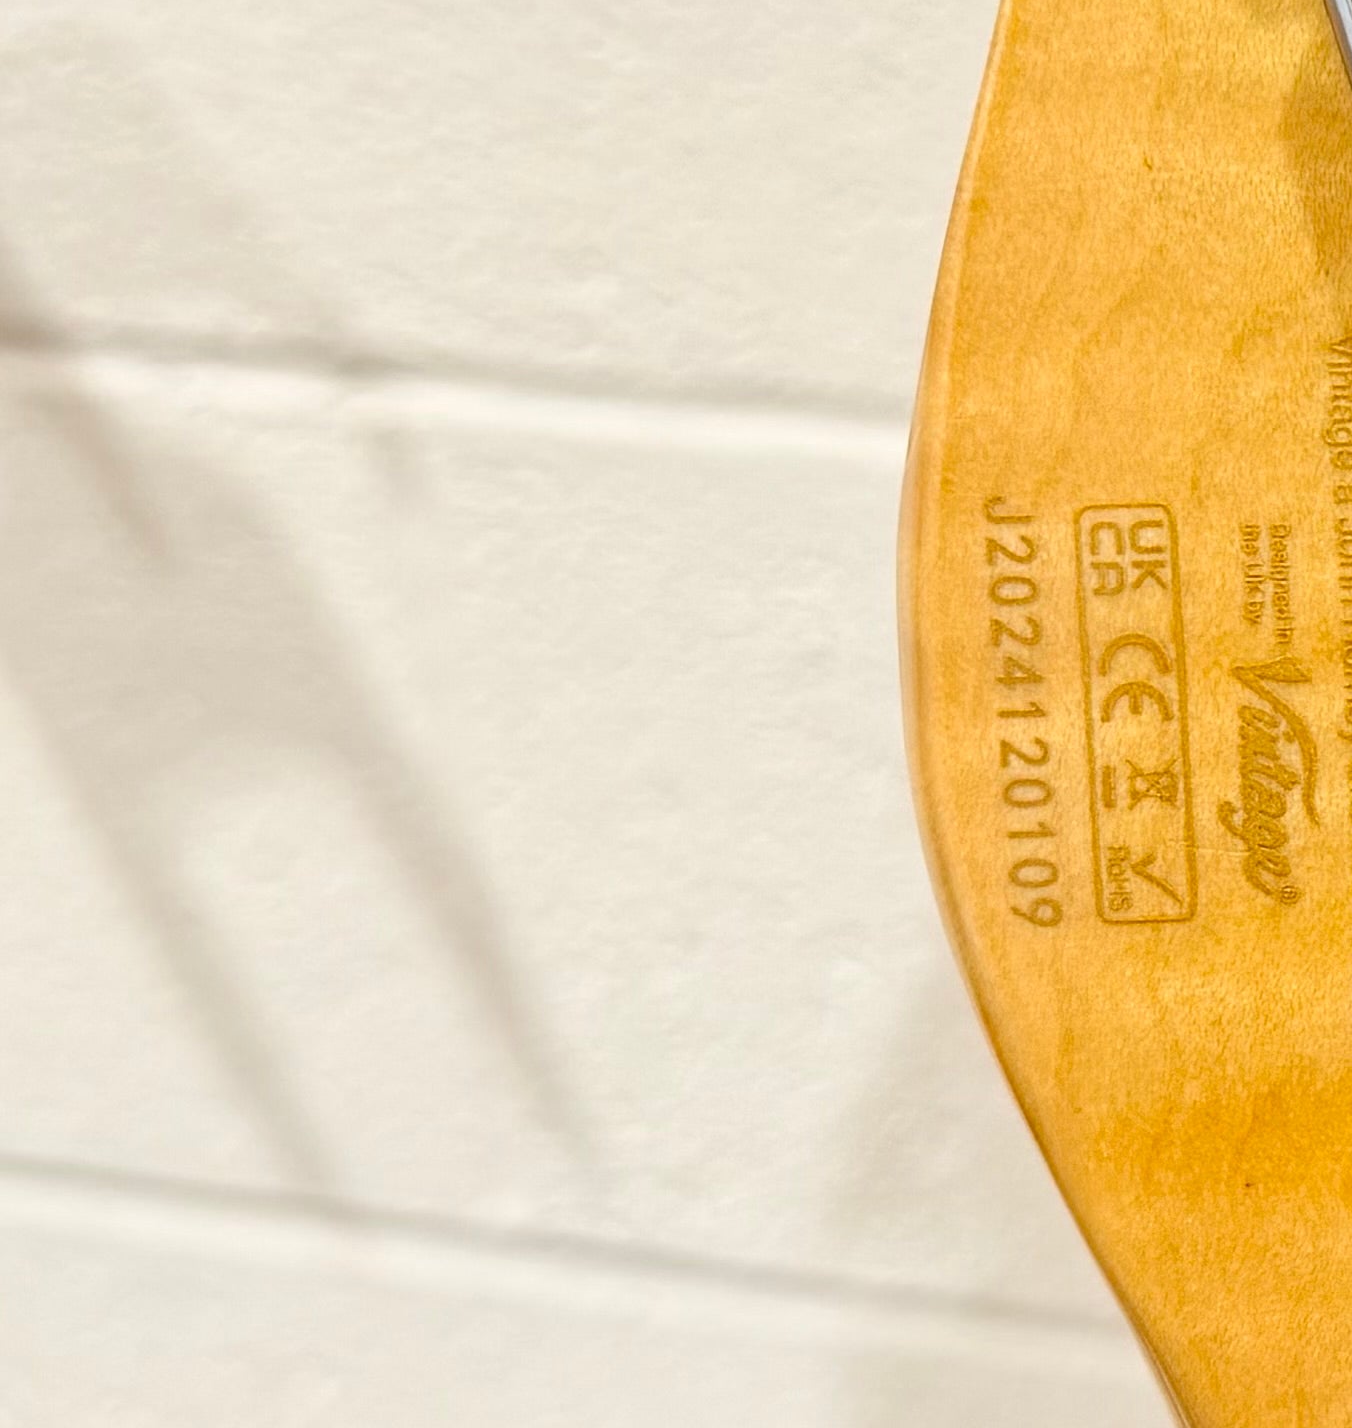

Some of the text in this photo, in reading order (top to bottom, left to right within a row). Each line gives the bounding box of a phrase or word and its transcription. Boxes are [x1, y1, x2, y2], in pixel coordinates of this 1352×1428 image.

[1088, 521, 1126, 596] CA
[1128, 519, 1168, 591] UK
[1268, 523, 1293, 621] Designed
[983, 495, 1063, 929] J2024120109
[1099, 632, 1174, 723] CE
[1106, 844, 1134, 913] RoHS
